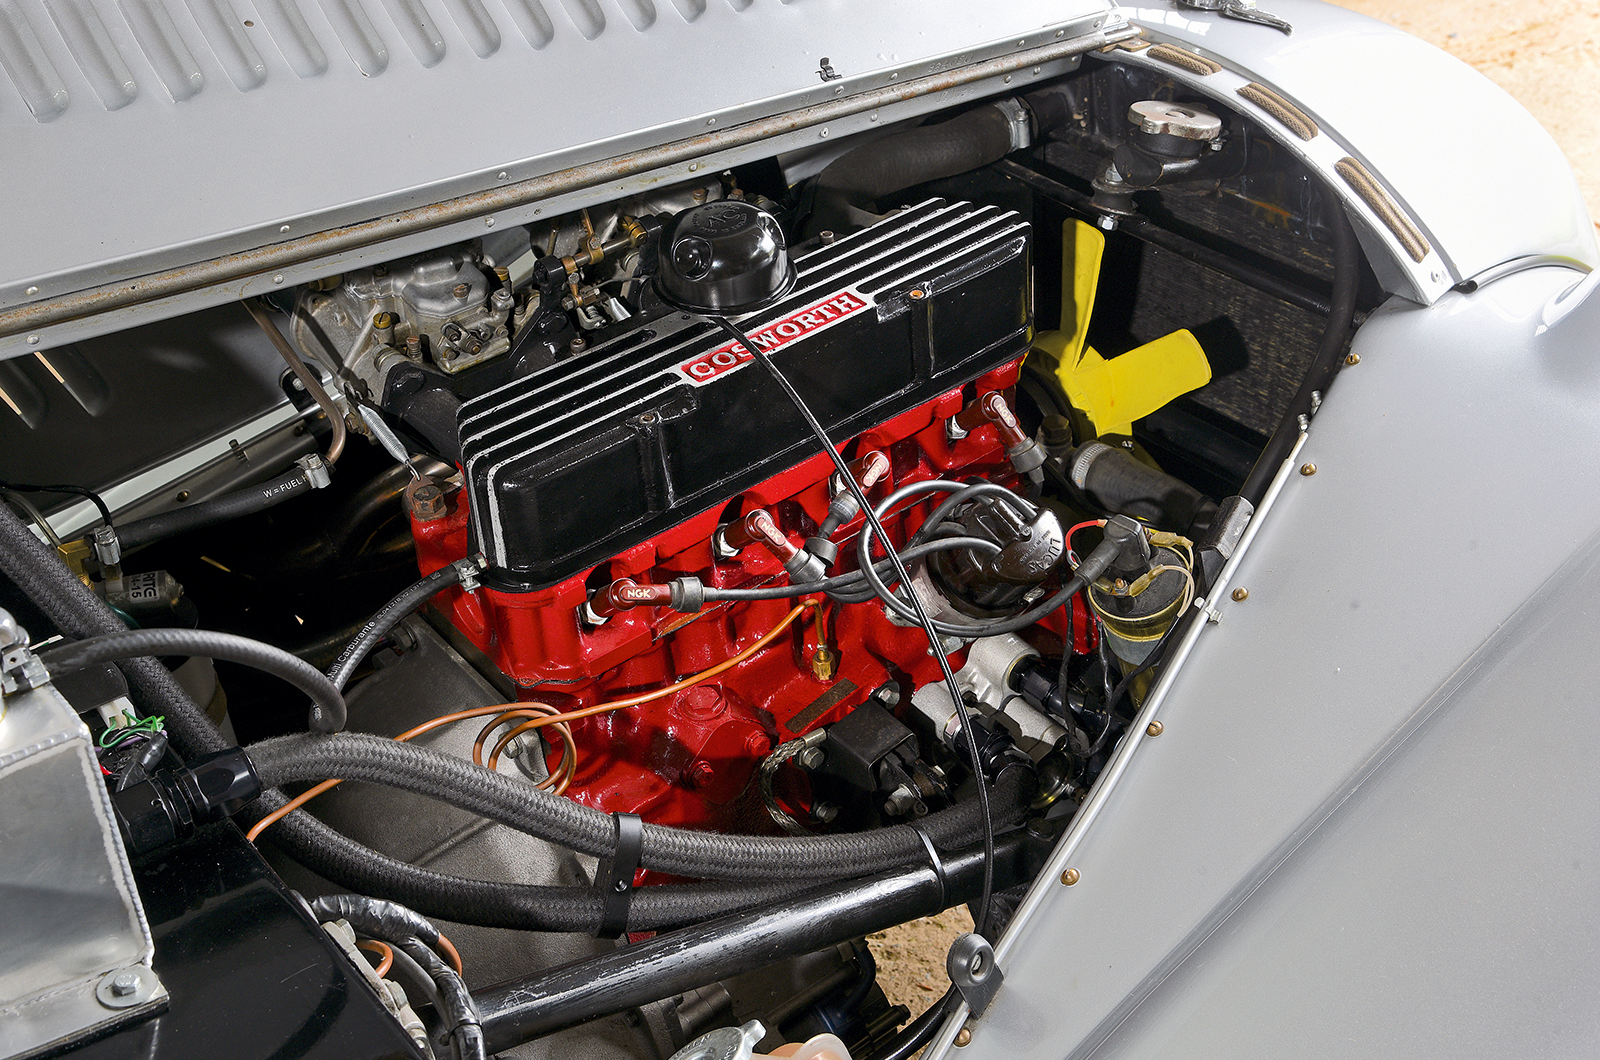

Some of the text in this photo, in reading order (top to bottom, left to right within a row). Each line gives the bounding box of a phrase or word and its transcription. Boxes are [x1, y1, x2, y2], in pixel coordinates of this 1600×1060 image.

[688, 294, 861, 378] COSWORTH
[996, 403, 1014, 424] NGK
[865, 462, 884, 483] NGK
[761, 521, 782, 543] NGK
[1027, 537, 1062, 575] LUCAS
[627, 588, 651, 599] NGK
[337, 620, 376, 663] Carburante
